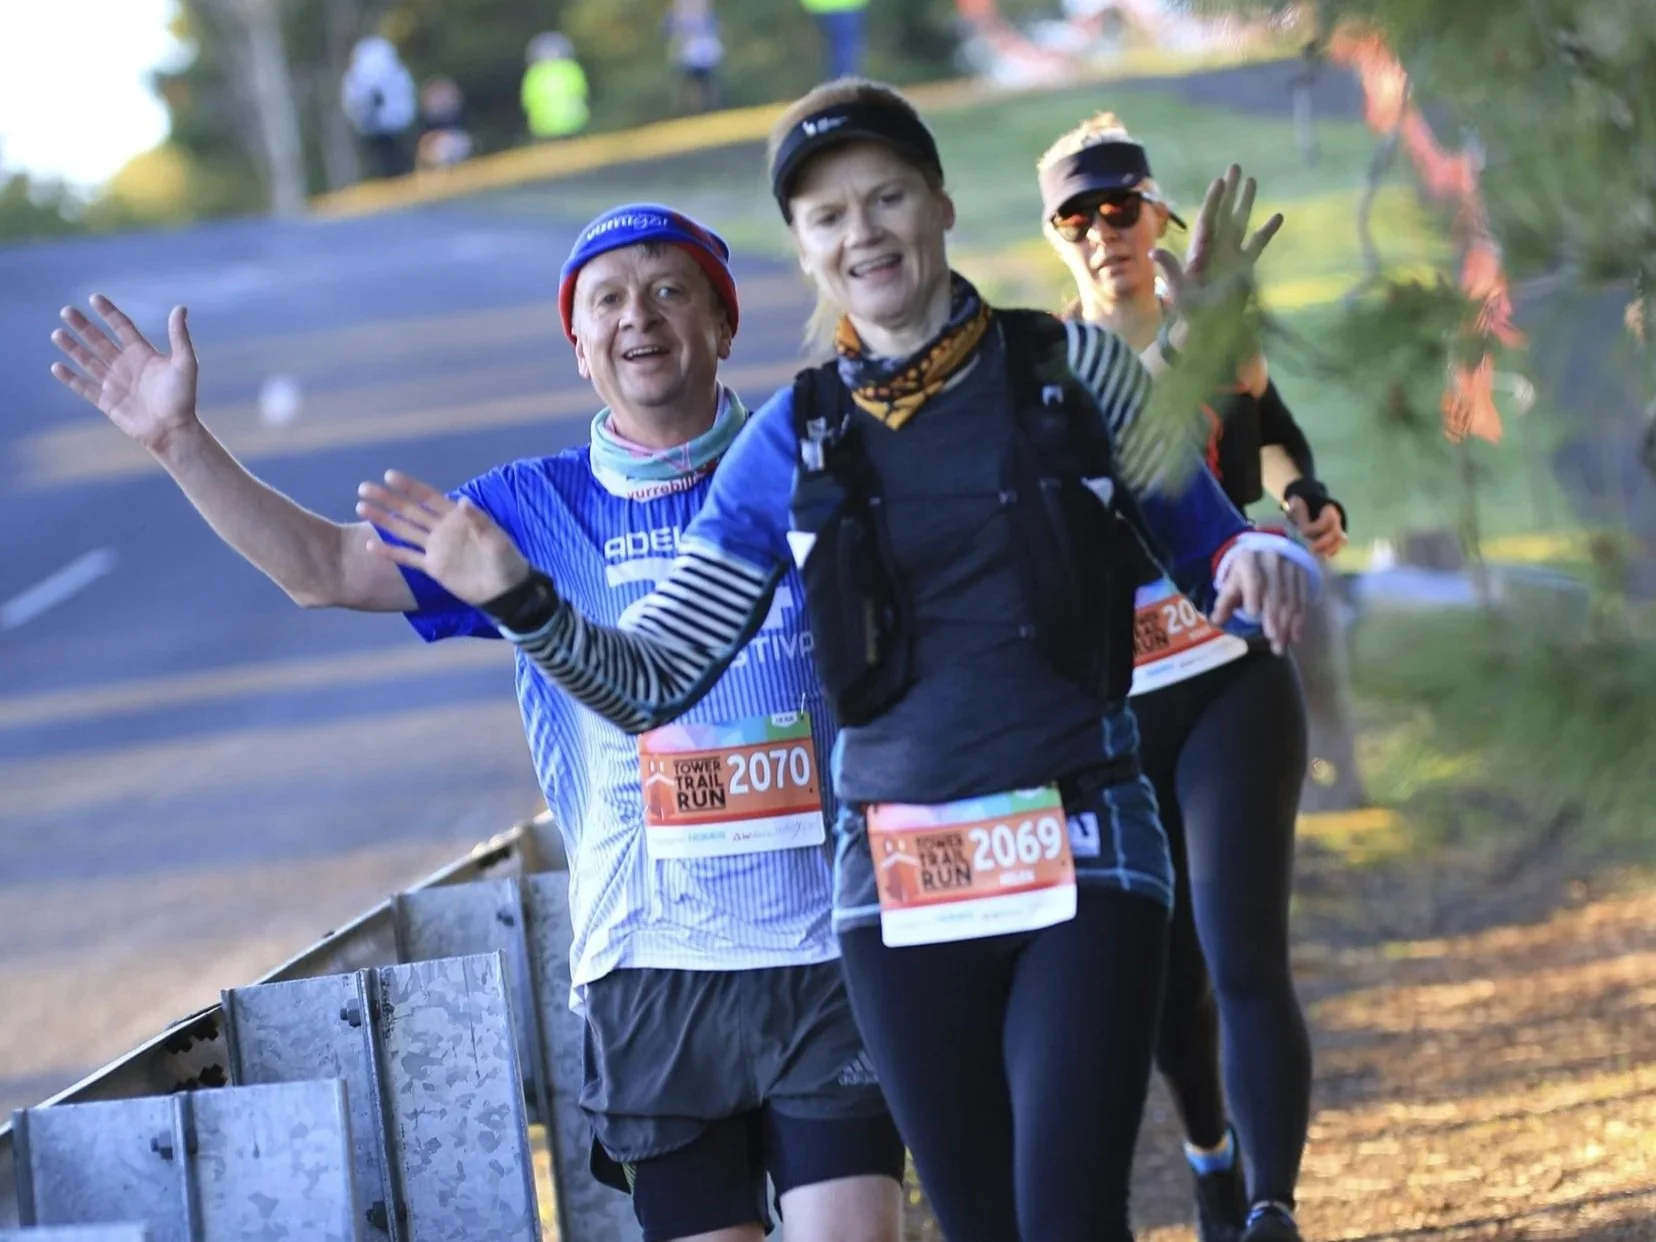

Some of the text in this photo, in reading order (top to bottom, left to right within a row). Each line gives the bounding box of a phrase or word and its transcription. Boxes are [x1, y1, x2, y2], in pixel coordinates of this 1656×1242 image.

[1162, 598, 1206, 635] 20
[673, 759, 721, 774] TOWER
[726, 747, 811, 795] 2070
[675, 773, 725, 790] TRAIL
[677, 789, 726, 809] RUN
[968, 816, 1062, 872] 2069
[922, 865, 972, 888] RUN
